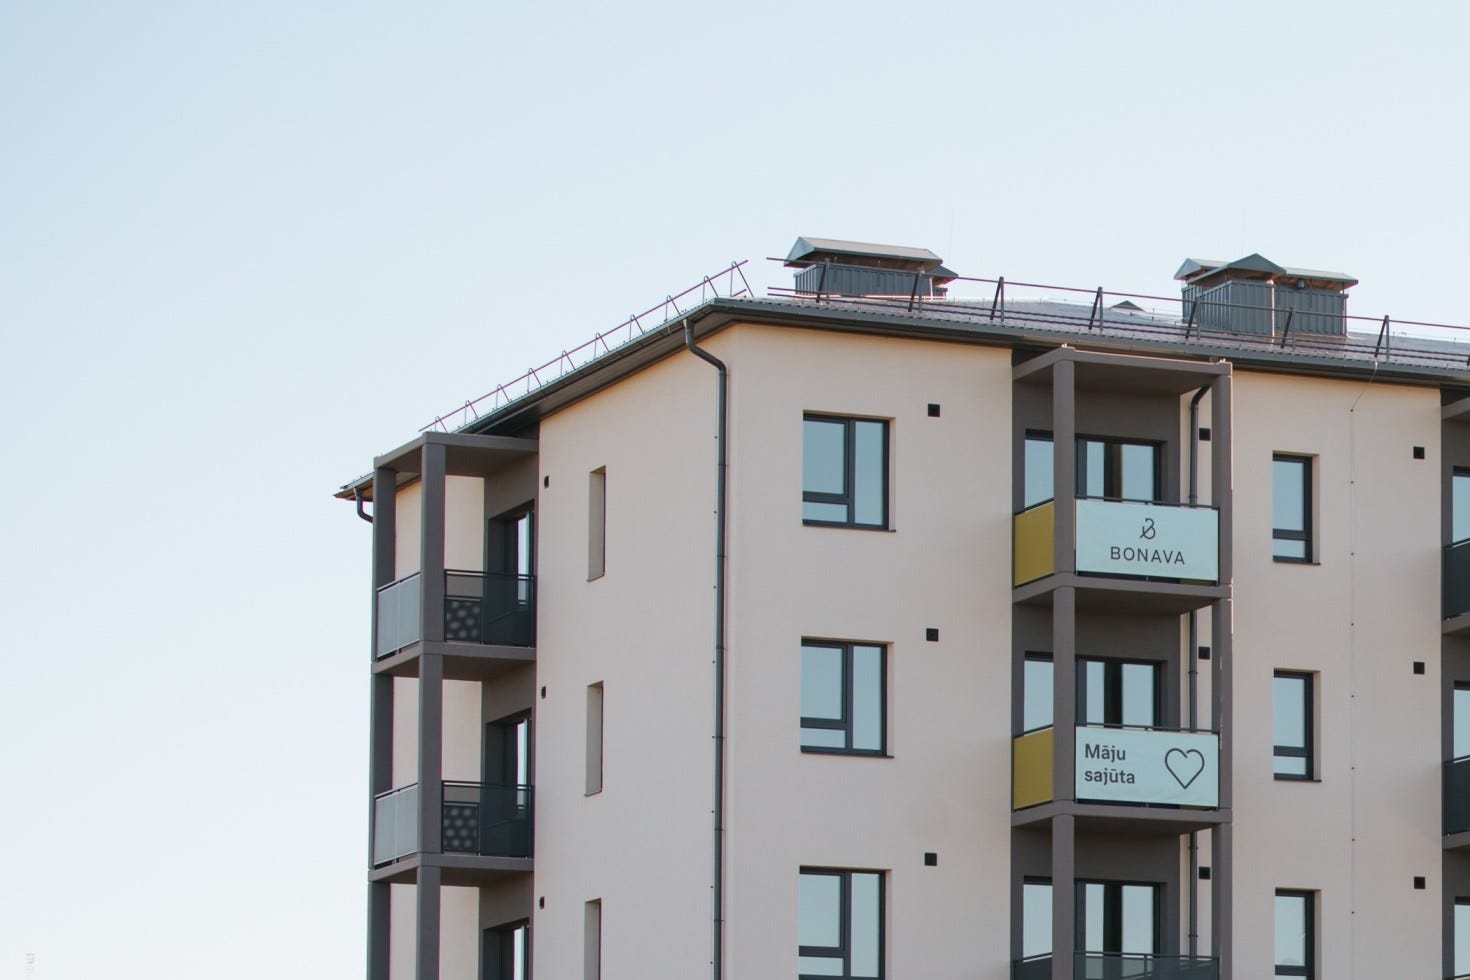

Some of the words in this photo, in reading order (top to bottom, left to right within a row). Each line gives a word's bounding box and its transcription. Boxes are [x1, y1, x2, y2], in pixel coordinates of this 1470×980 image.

[1110, 546, 1185, 565] BONAVA
[1084, 743, 1126, 763] Māju
[1084, 768, 1135, 785] sajūta
